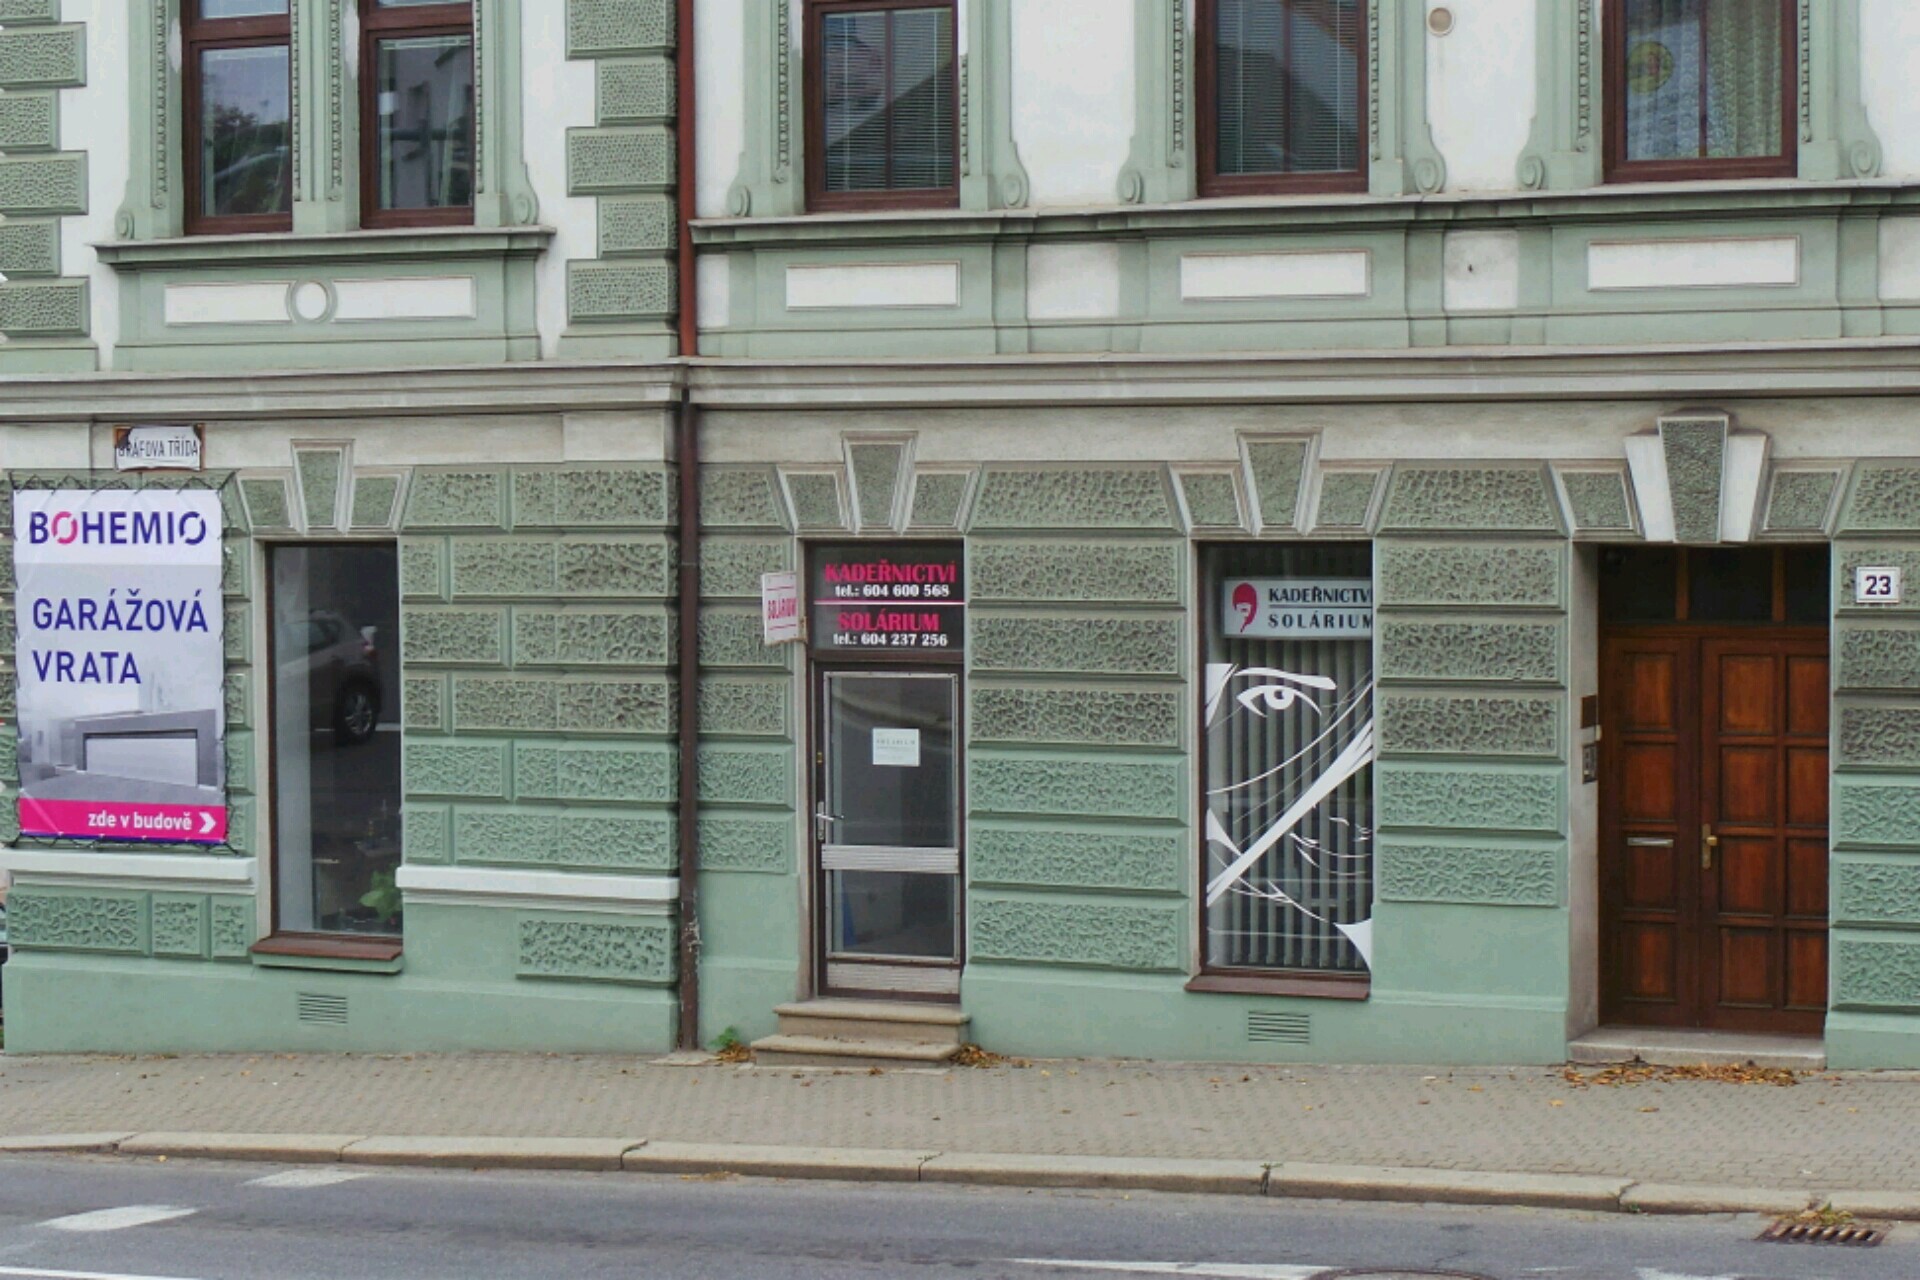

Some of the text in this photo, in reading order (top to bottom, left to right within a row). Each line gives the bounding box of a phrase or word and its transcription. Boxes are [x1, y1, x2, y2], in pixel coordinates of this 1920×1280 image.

[29, 511, 207, 545] BOHEMIO
[824, 558, 957, 582] KADEŘNICTVÍ
[863, 584, 889, 597] 604
[893, 584, 919, 597] 600
[1269, 586, 1373, 603] KADEŘNICTV
[1865, 575, 1891, 595] 23
[32, 588, 209, 632] GARÁŽOVÁ
[837, 608, 940, 631] SOLÁRIUM
[861, 633, 887, 646] 604
[890, 633, 917, 646] 237
[921, 634, 948, 647] 256
[32, 650, 142, 684] VRATA
[88, 810, 193, 830] zde v budově
